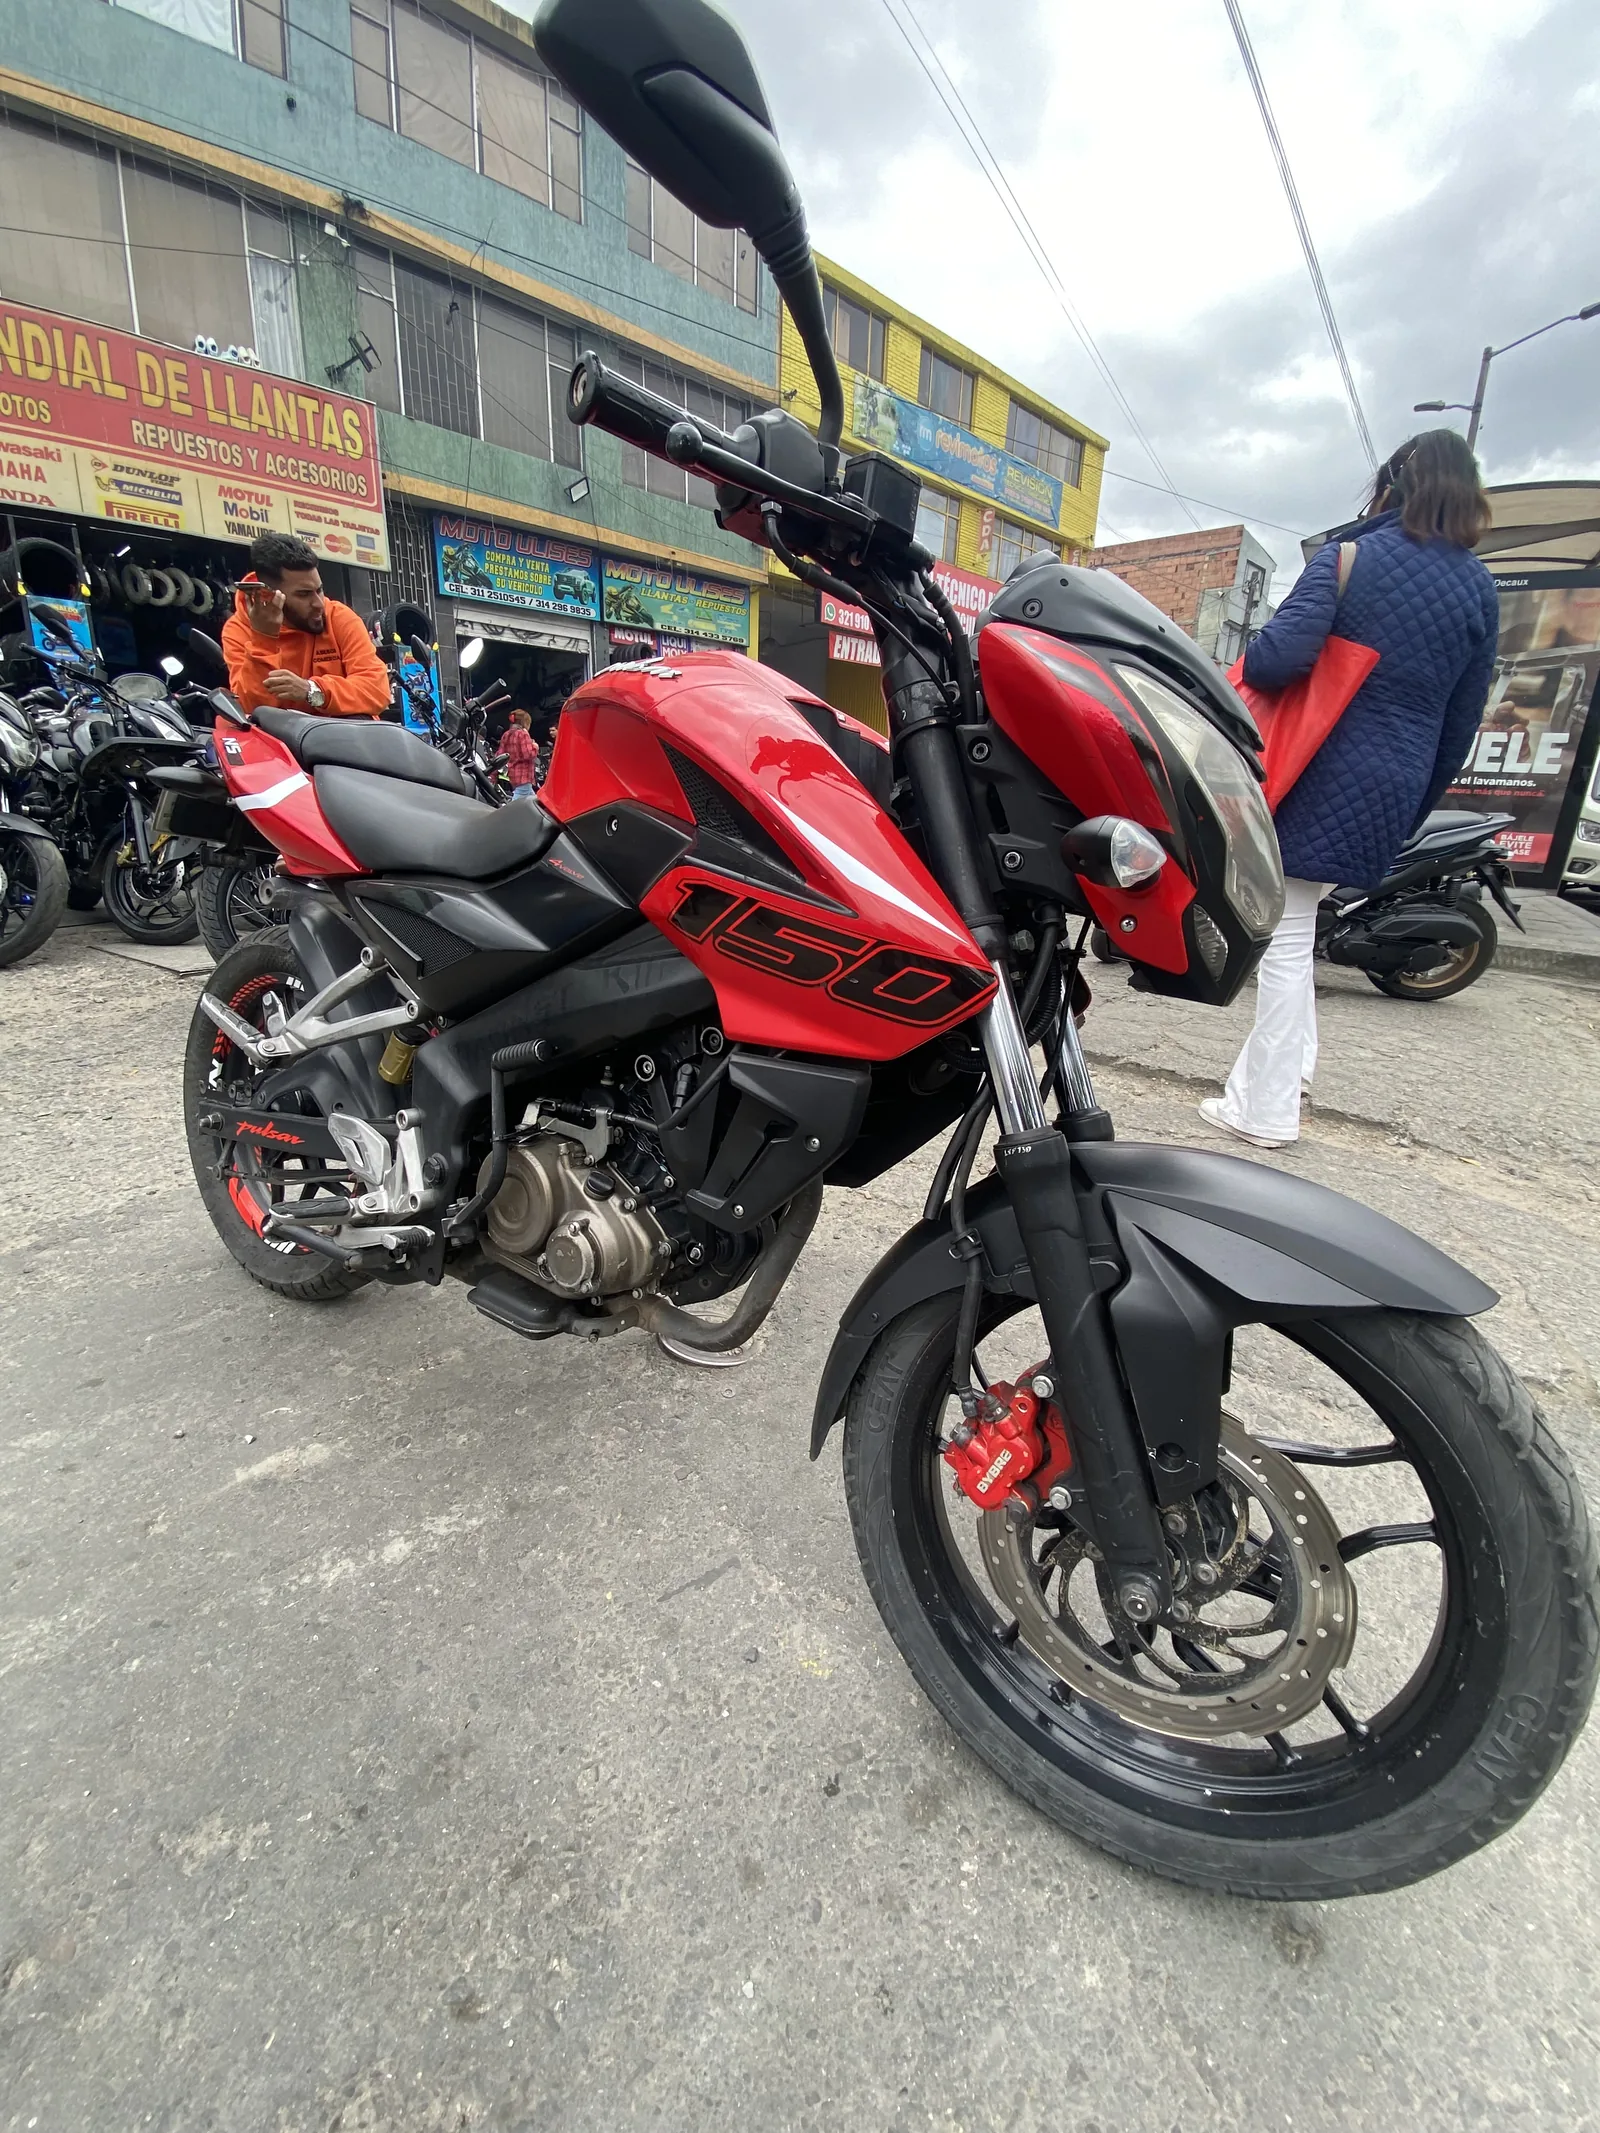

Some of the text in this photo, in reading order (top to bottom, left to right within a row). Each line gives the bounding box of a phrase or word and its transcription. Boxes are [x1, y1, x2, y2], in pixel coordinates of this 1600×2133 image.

[0, 316, 365, 460] NDIAL DE LLANTAS
[0, 391, 51, 424] OTOS
[131, 419, 368, 498] REPUESTOS Y ACCESORIOS
[936, 428, 997, 476] revimotos
[112, 464, 181, 483] DUNLOP
[122, 484, 181, 502] MICHELIN
[218, 485, 273, 507] MOTUL
[104, 500, 180, 529] PIRELLI
[223, 501, 269, 523] Mobil
[224, 520, 276, 538] YAMALU
[440, 516, 593, 568] MOTO ULISES
[485, 551, 550, 573] COMPRA Y VENTA
[484, 562, 552, 585] PRESTAMOS SOBRE
[605, 559, 746, 605] MOTO ULISES
[1494, 578, 1529, 588] Decaux
[449, 583, 469, 595] CEL:
[470, 587, 485, 598] 311
[487, 590, 526, 604] 2510545
[535, 599, 550, 609] 314
[552, 602, 568, 612] 296
[496, 577, 544, 596] SU VEHICULO
[936, 572, 986, 613] TÉCNICO
[640, 587, 748, 617] LLANTAS REPUESTOS
[660, 624, 682, 633] CEL:
[684, 628, 700, 636] 314
[838, 608, 870, 631] 321 910
[614, 627, 654, 645] MOTUL
[661, 635, 687, 649] LIQUI
[833, 634, 881, 665] ENTRAD
[221, 737, 242, 754] NS
[1460, 776, 1472, 785] el
[1473, 776, 1537, 787] lavamanos.
[1473, 787, 1492, 795] más
[1494, 789, 1512, 797] que
[1499, 841, 1532, 850] EVITE
[1500, 832, 1535, 842] BÁJELE
[668, 878, 998, 1027] 150
[236, 1120, 306, 1145] pulsar
[976, 1449, 1013, 1494] BYBRE
